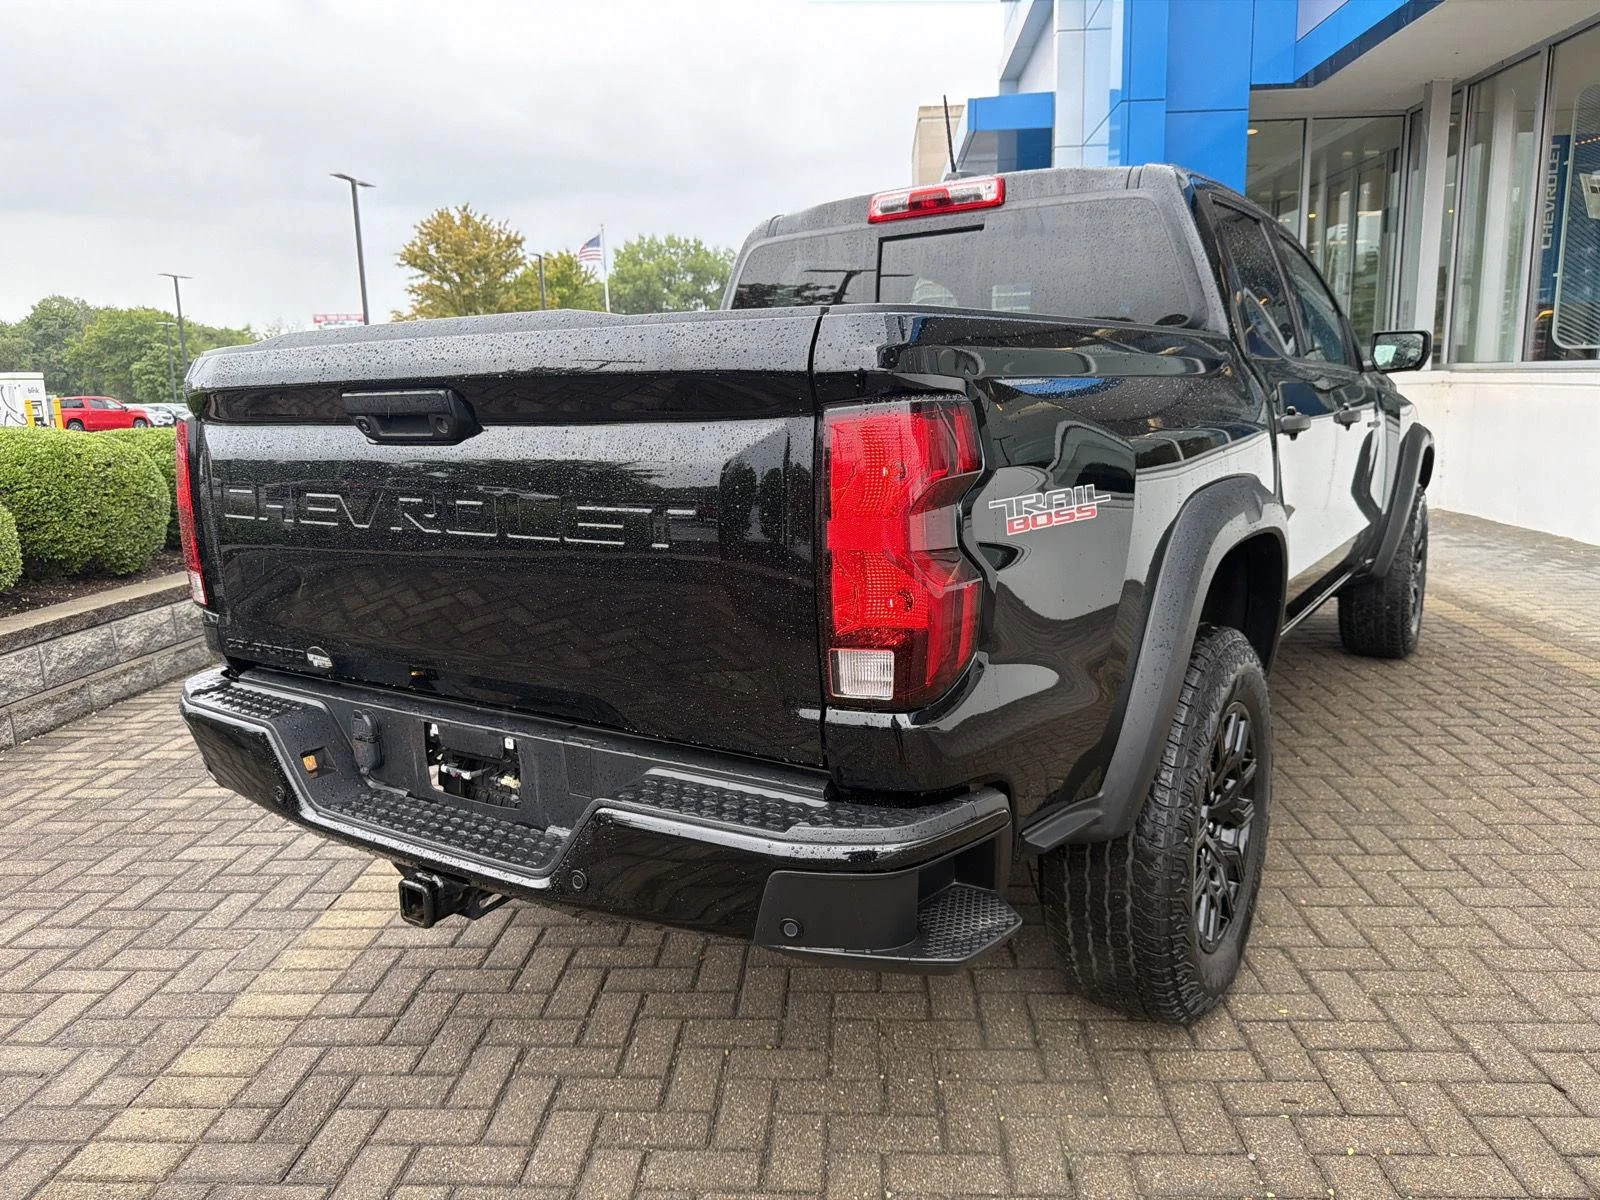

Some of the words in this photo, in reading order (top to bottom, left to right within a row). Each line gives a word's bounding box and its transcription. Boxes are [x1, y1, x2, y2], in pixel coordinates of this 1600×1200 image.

[1542, 144, 1560, 249] CHEVROLET
[222, 484, 698, 549] CHEVROLET
[988, 483, 1111, 519] TRAIL
[1006, 503, 1097, 535] BOSS
